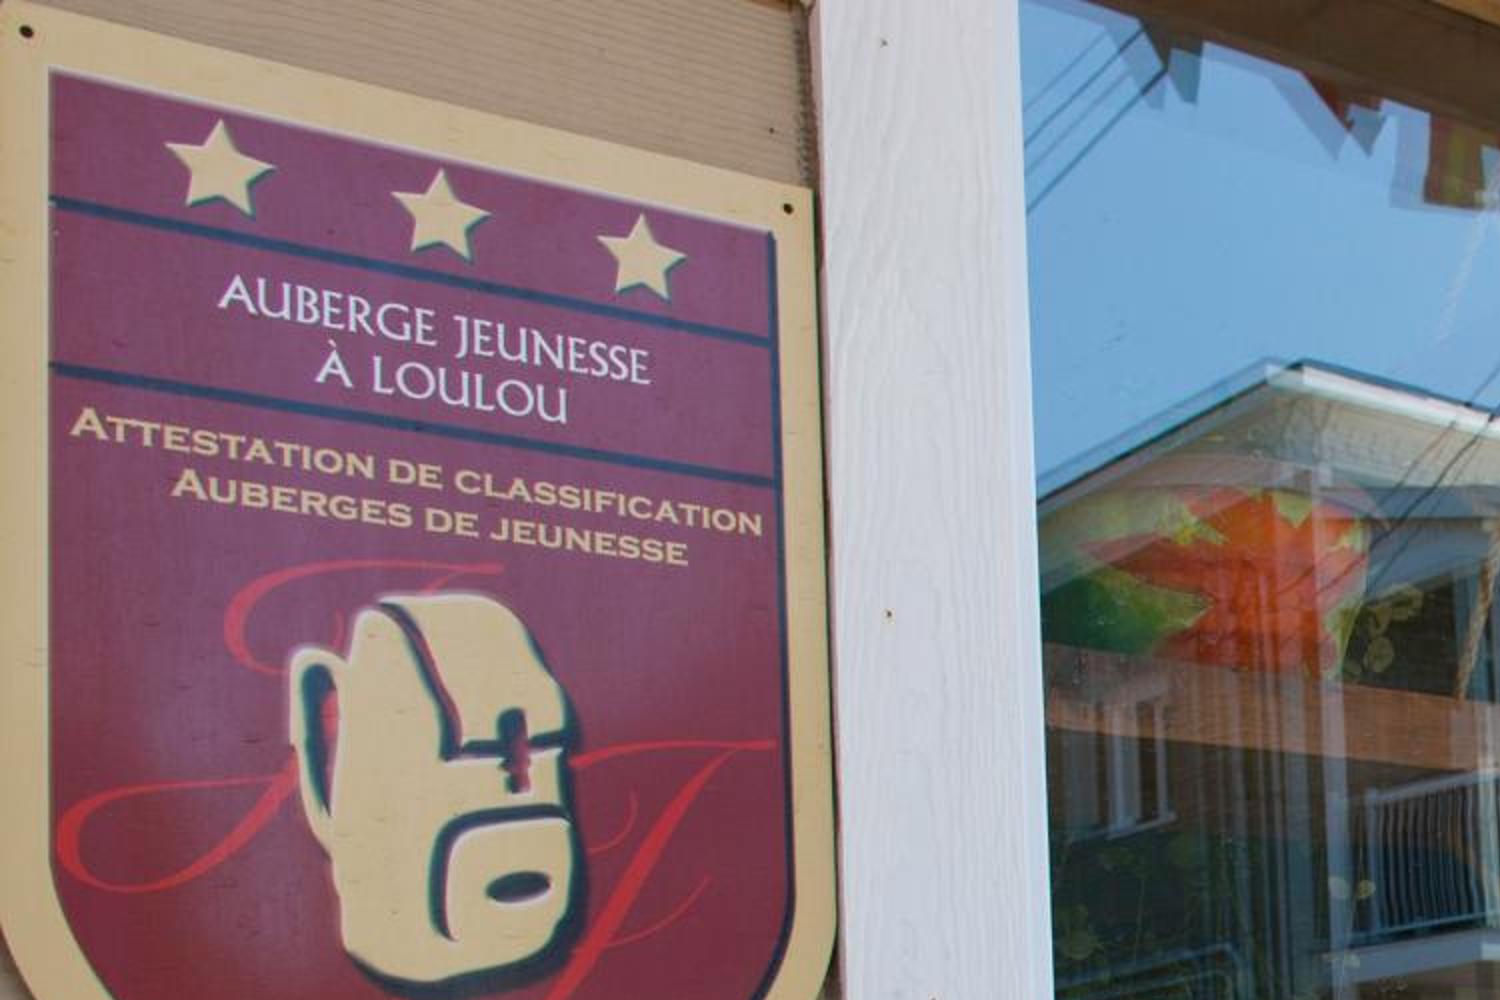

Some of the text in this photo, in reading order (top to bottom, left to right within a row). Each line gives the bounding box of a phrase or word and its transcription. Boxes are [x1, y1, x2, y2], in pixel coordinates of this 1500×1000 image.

[218, 274, 652, 385] AUBERGE JEUNESSE
[314, 339, 568, 424] À LOULOU
